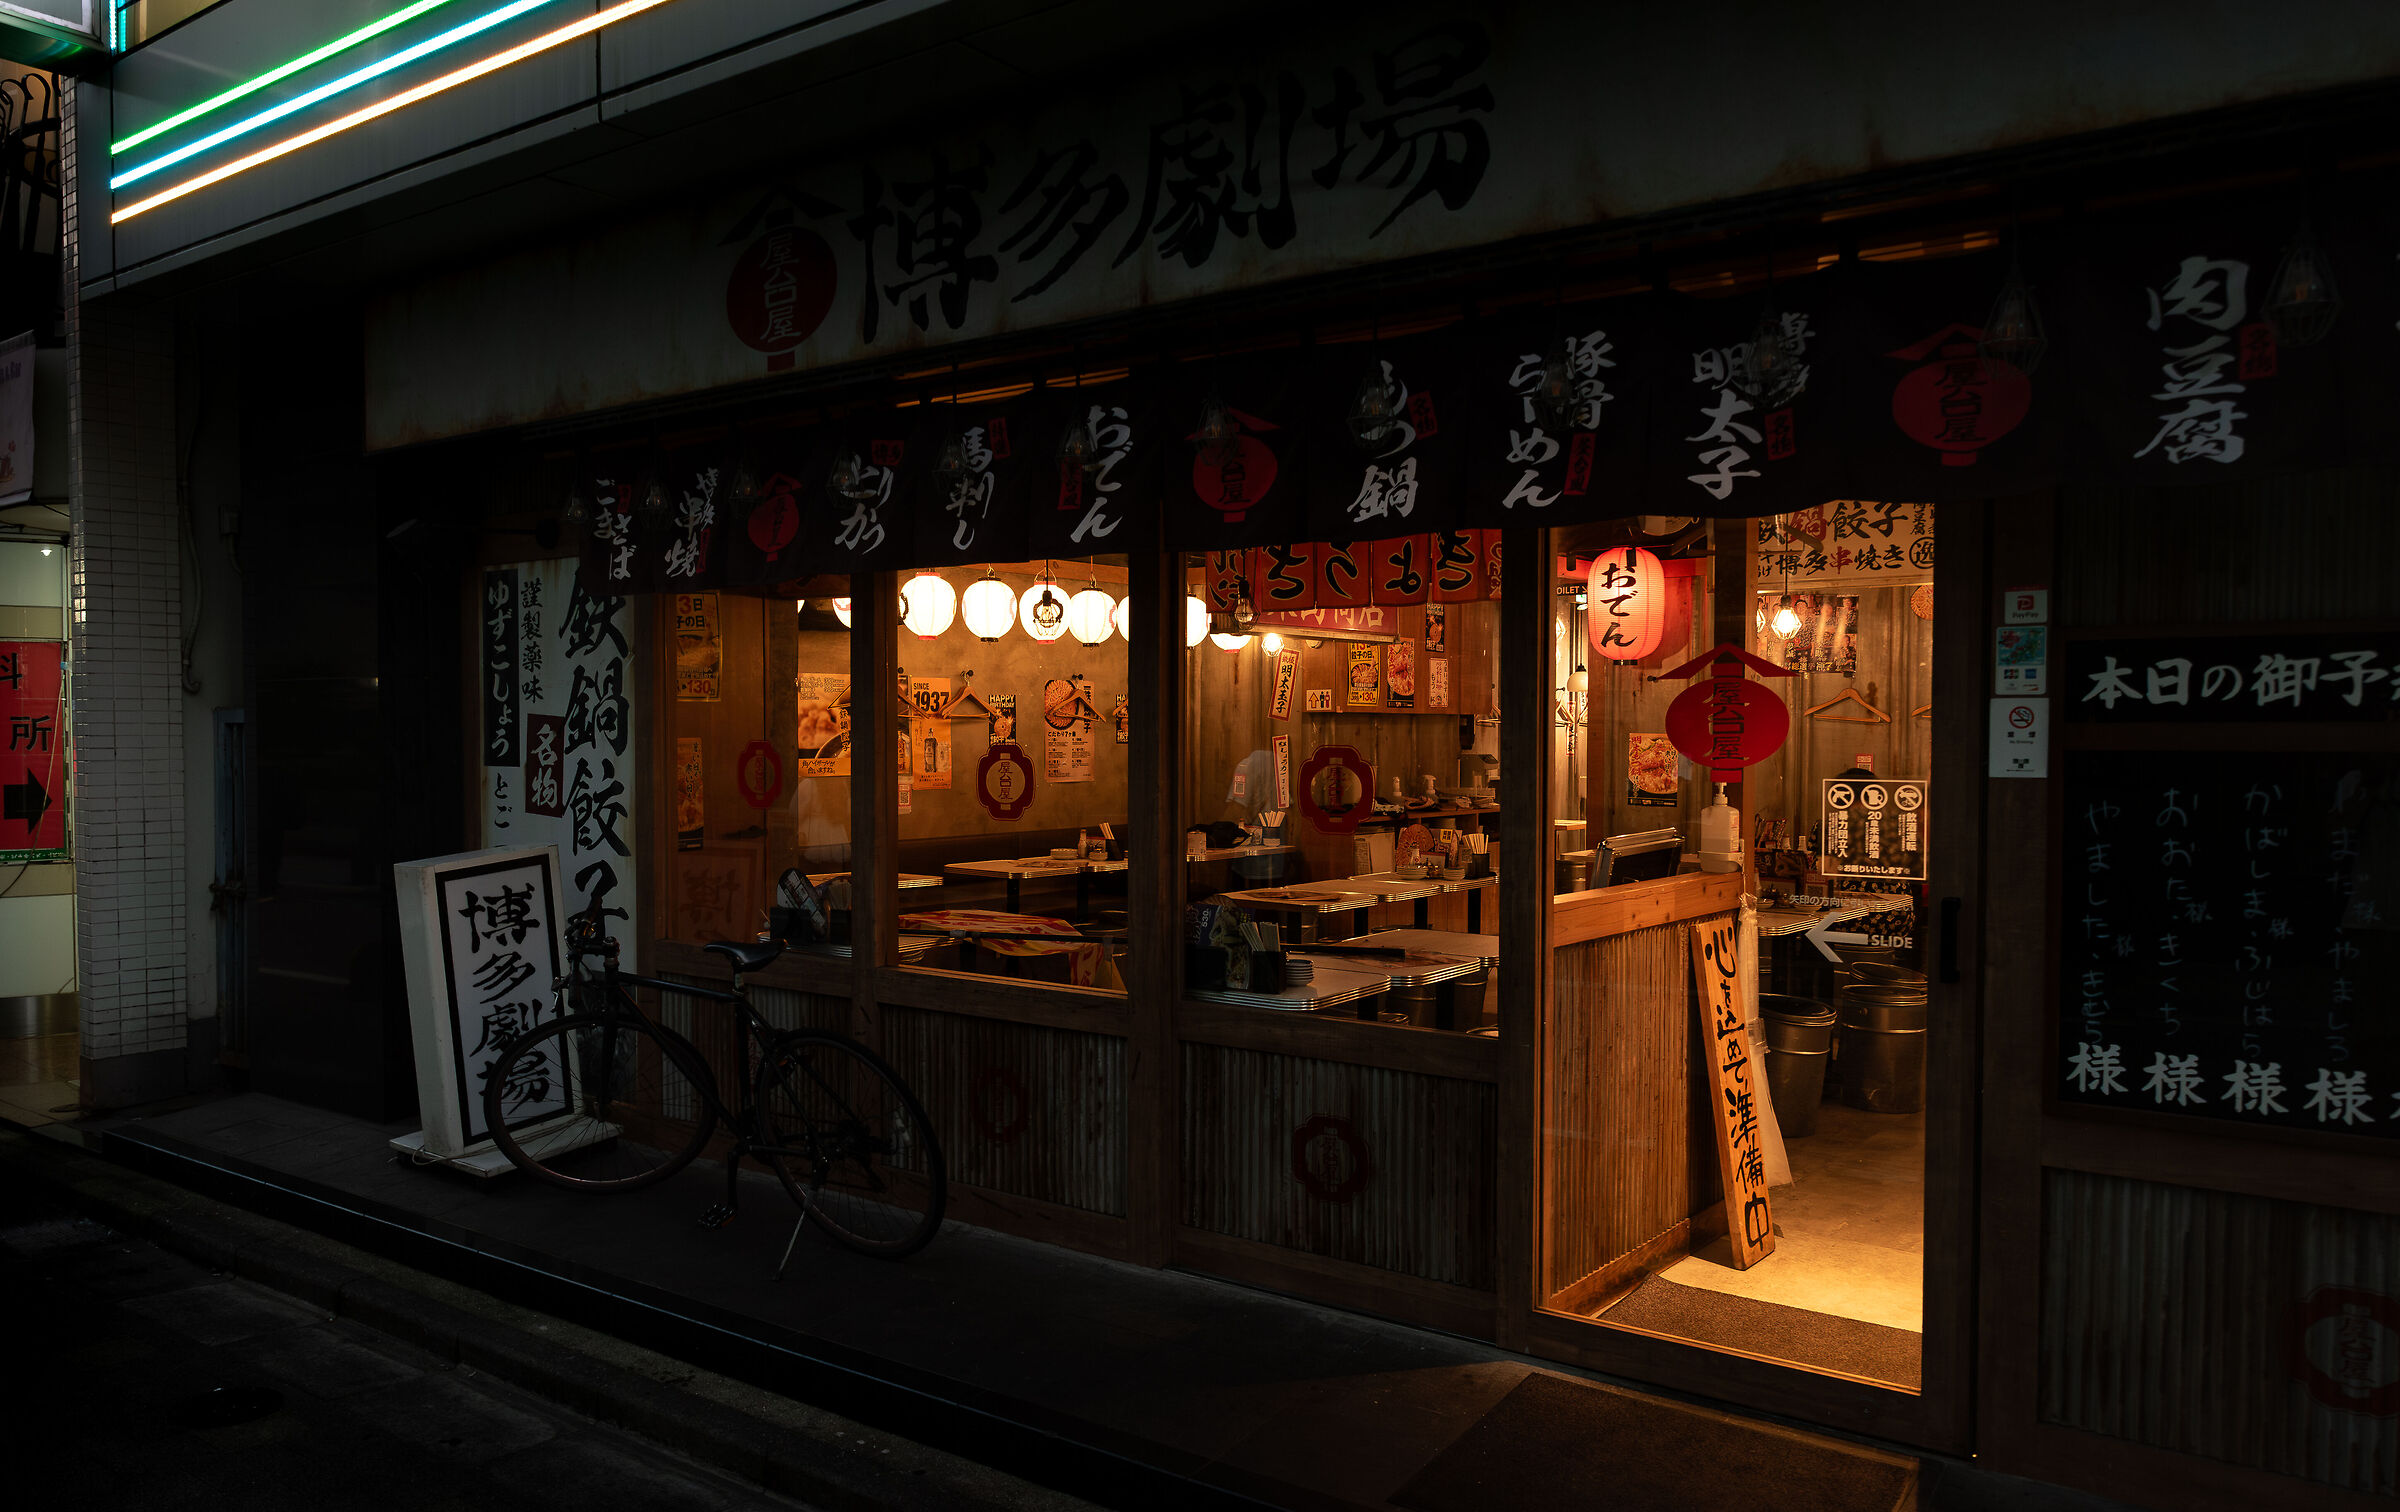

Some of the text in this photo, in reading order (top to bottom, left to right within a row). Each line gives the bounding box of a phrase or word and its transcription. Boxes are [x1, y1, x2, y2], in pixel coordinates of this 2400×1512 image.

[846, 22, 1495, 344] 博多劇場
[760, 232, 801, 344] 屋台屋
[2134, 256, 2251, 465] 肉豆腐
[1683, 343, 1763, 500] 明太子
[1938, 361, 1987, 443] 屋台屋
[946, 425, 994, 551] 馬刺し
[1069, 404, 1132, 544] おでん
[1775, 544, 1905, 576] 博多串焼き
[521, 577, 544, 704] 謹製薬味
[1600, 562, 1638, 648] おでん
[487, 579, 512, 760] ゆずこしょう
[913, 682, 930, 690] SINCE
[913, 691, 950, 713] 1937
[990, 694, 1014, 703] HAPPY
[2081, 651, 2400, 710] 本日の御予
[1701, 680, 1751, 762] 屋台屋
[530, 722, 559, 809] 名物
[998, 761, 1013, 800] 屋台屋
[1837, 810, 1849, 858] 暴力団立入
[1871, 934, 1913, 949] SLIDE
[459, 883, 549, 1116] 博多劇場
[2065, 1041, 2130, 1096] 様
[2140, 1051, 2207, 1107] 様
[2221, 1059, 2289, 1117] 様
[2304, 1066, 2376, 1126] 様
